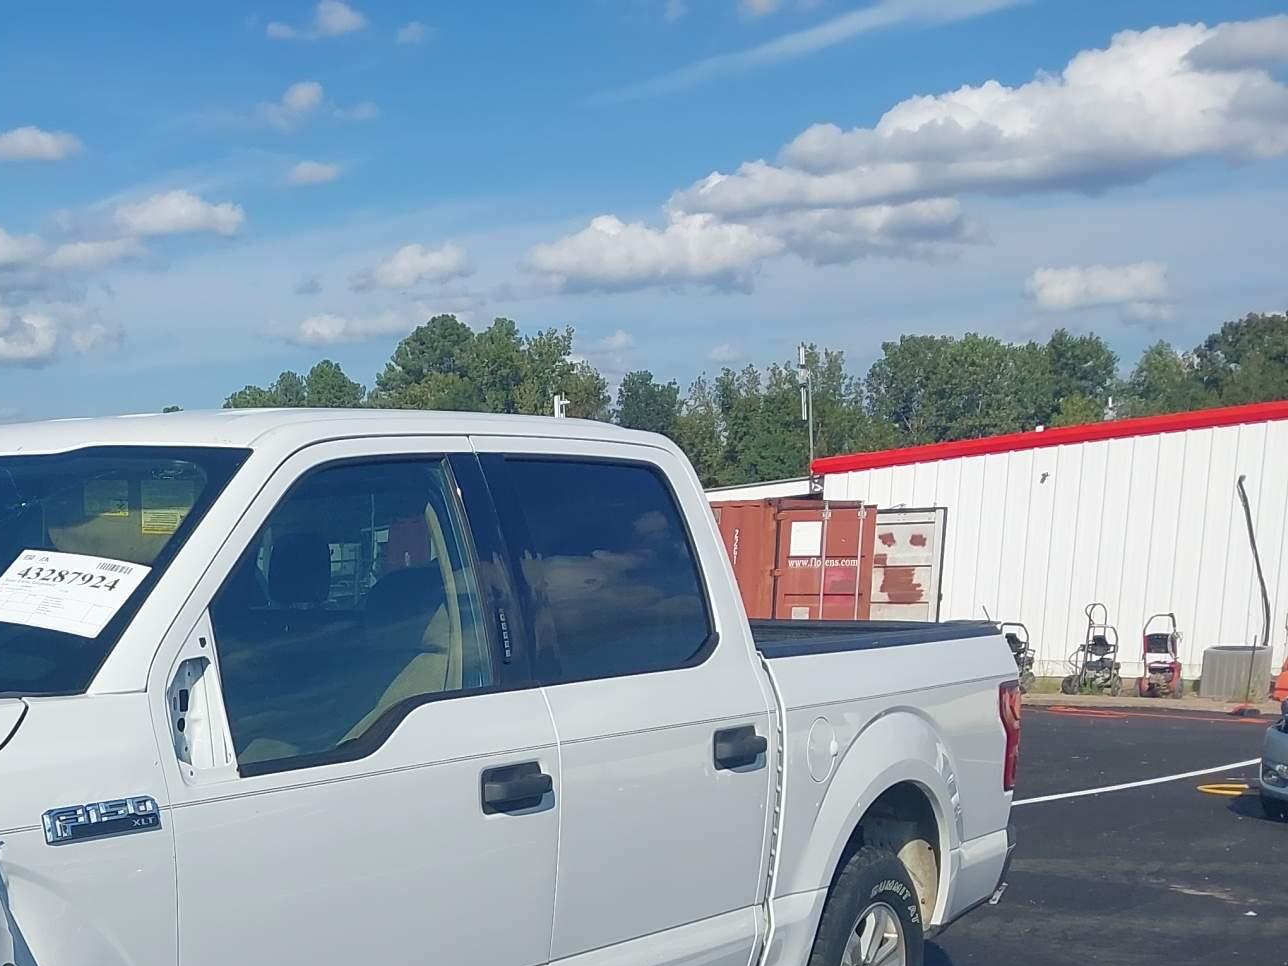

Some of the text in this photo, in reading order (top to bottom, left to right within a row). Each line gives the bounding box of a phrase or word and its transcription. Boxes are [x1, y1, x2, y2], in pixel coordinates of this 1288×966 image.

[17, 566, 120, 591] 43287924
[132, 816, 154, 827] XLT
[870, 880, 911, 900] SUMMIT
